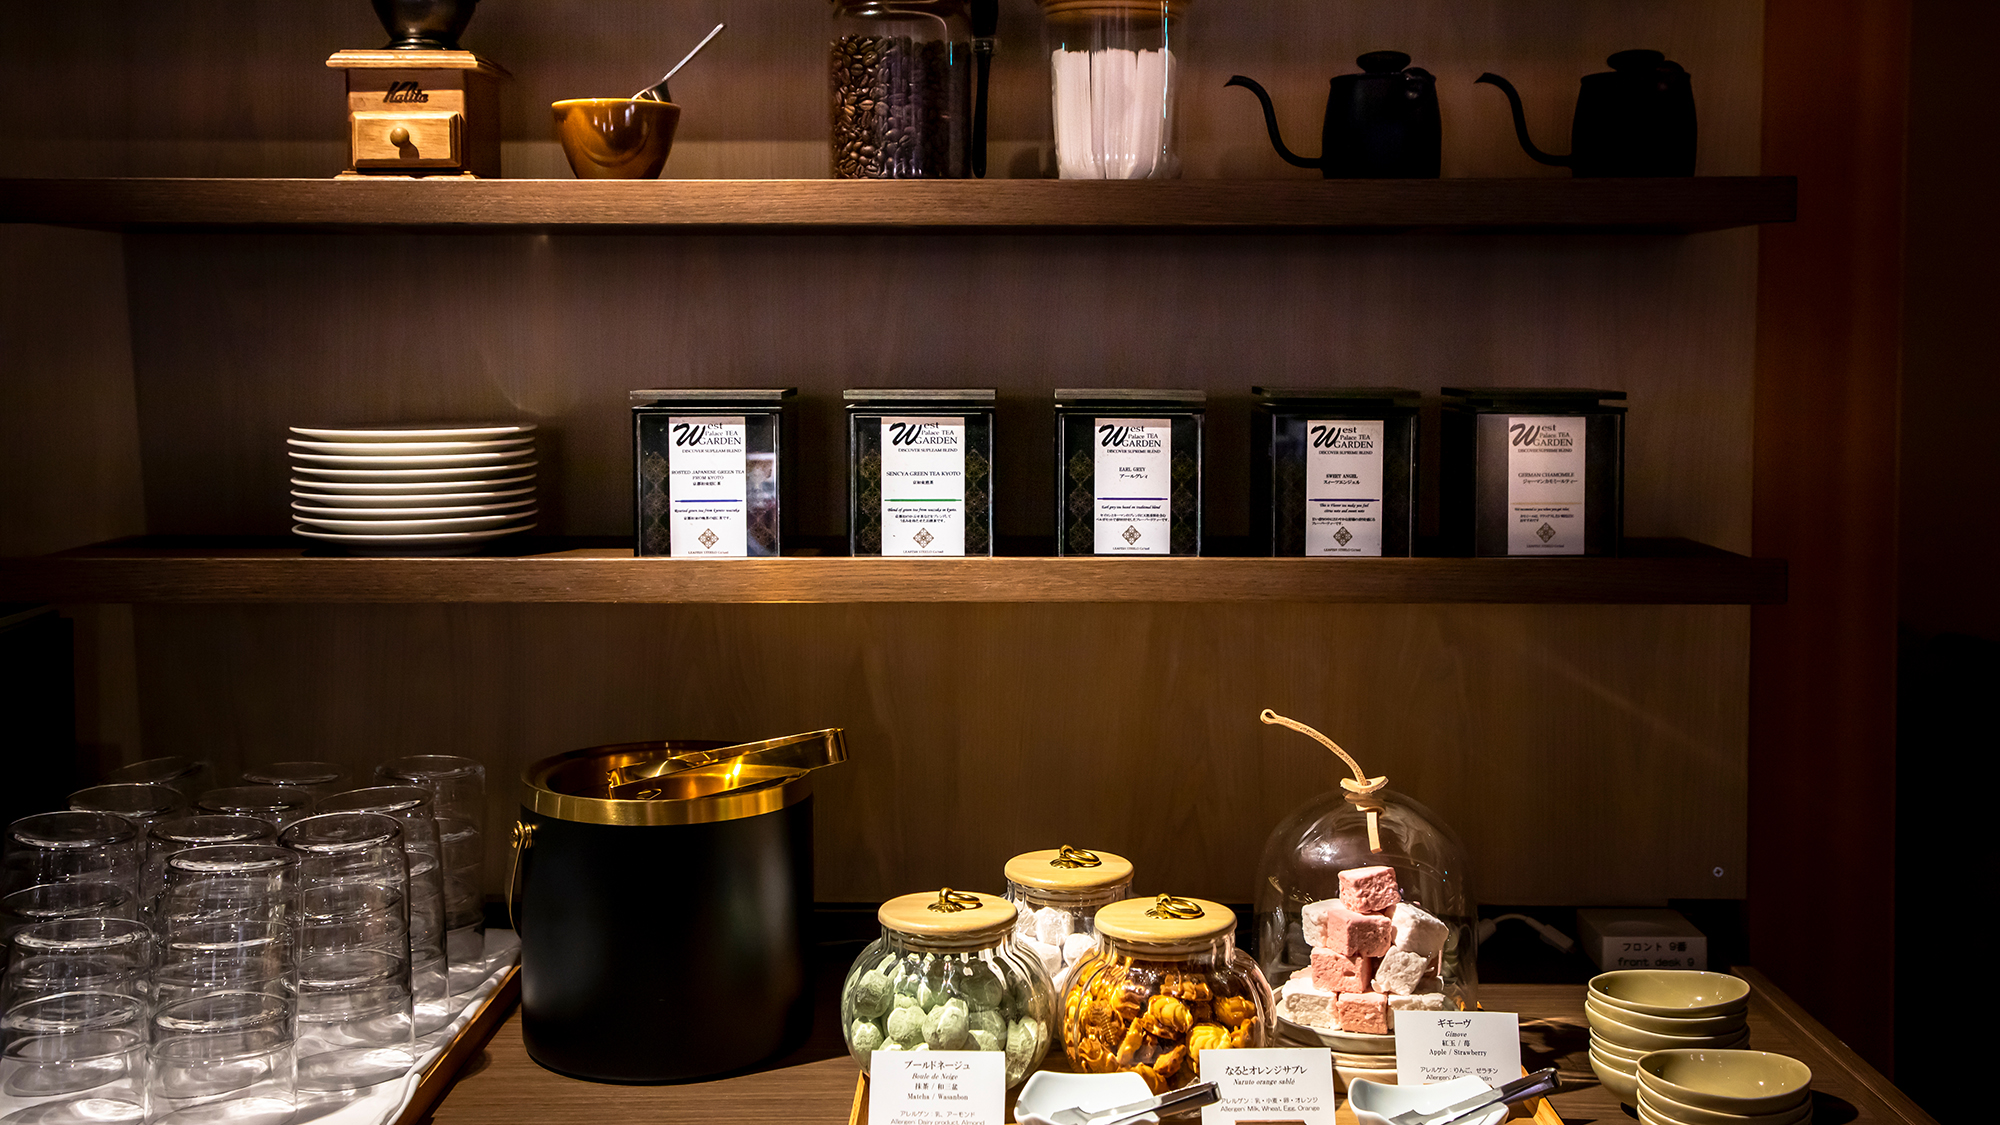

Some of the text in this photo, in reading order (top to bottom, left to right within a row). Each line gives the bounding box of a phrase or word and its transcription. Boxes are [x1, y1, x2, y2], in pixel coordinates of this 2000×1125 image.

[383, 81, 428, 103] Kalita
[698, 437, 741, 445] GARDEN
[1622, 942, 1687, 952] フロント 9番
[1618, 957, 1694, 967] front desk 9
[1438, 1019, 1471, 1028] ギモーヴ
[904, 1060, 970, 1070] ブールドネージュ
[1225, 1066, 1308, 1076] なるとオレンジサブレ
